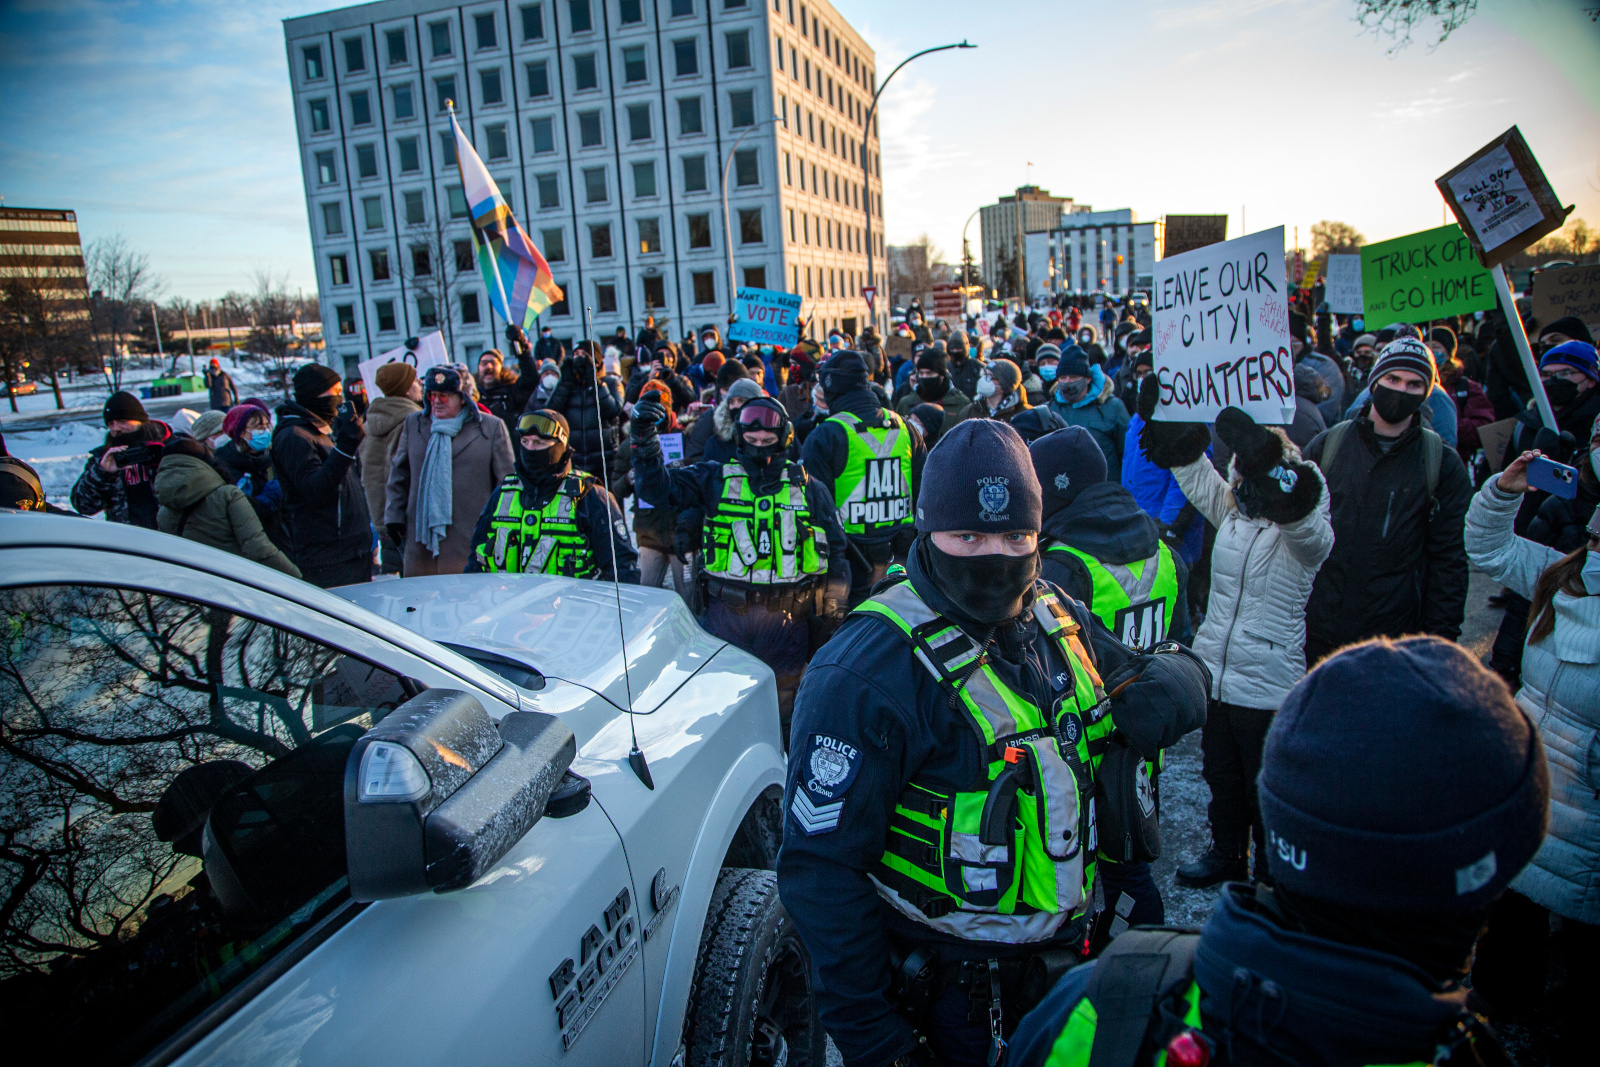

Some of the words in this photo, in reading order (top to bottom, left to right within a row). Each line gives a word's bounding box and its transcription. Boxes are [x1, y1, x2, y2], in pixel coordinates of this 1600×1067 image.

[1463, 180, 1489, 202] CALL
[1489, 168, 1512, 182] OUT
[1500, 201, 1530, 222] COMMUNITY
[1371, 244, 1438, 280] TRUCK
[1155, 266, 1211, 312] LEAVE
[1219, 252, 1277, 297] OUR
[1559, 272, 1579, 285] GO
[737, 290, 760, 301] WANT
[777, 296, 801, 309] HEARD
[1369, 301, 1387, 312] AND
[1391, 287, 1424, 312] GO
[1432, 273, 1487, 306] HOME
[747, 303, 790, 326] VOTE
[1182, 298, 1250, 348] CITY!
[750, 328, 796, 344] DEMOCRACY
[1157, 346, 1293, 409] SQUATTERS
[867, 458, 900, 499] A41
[976, 476, 1010, 486] POLICE
[850, 497, 910, 524] POLICE
[758, 542, 770, 554] 42
[759, 531, 770, 543] A
[815, 734, 858, 760] POLICE
[549, 886, 632, 1001] RAM
[556, 914, 635, 1030] 2500
